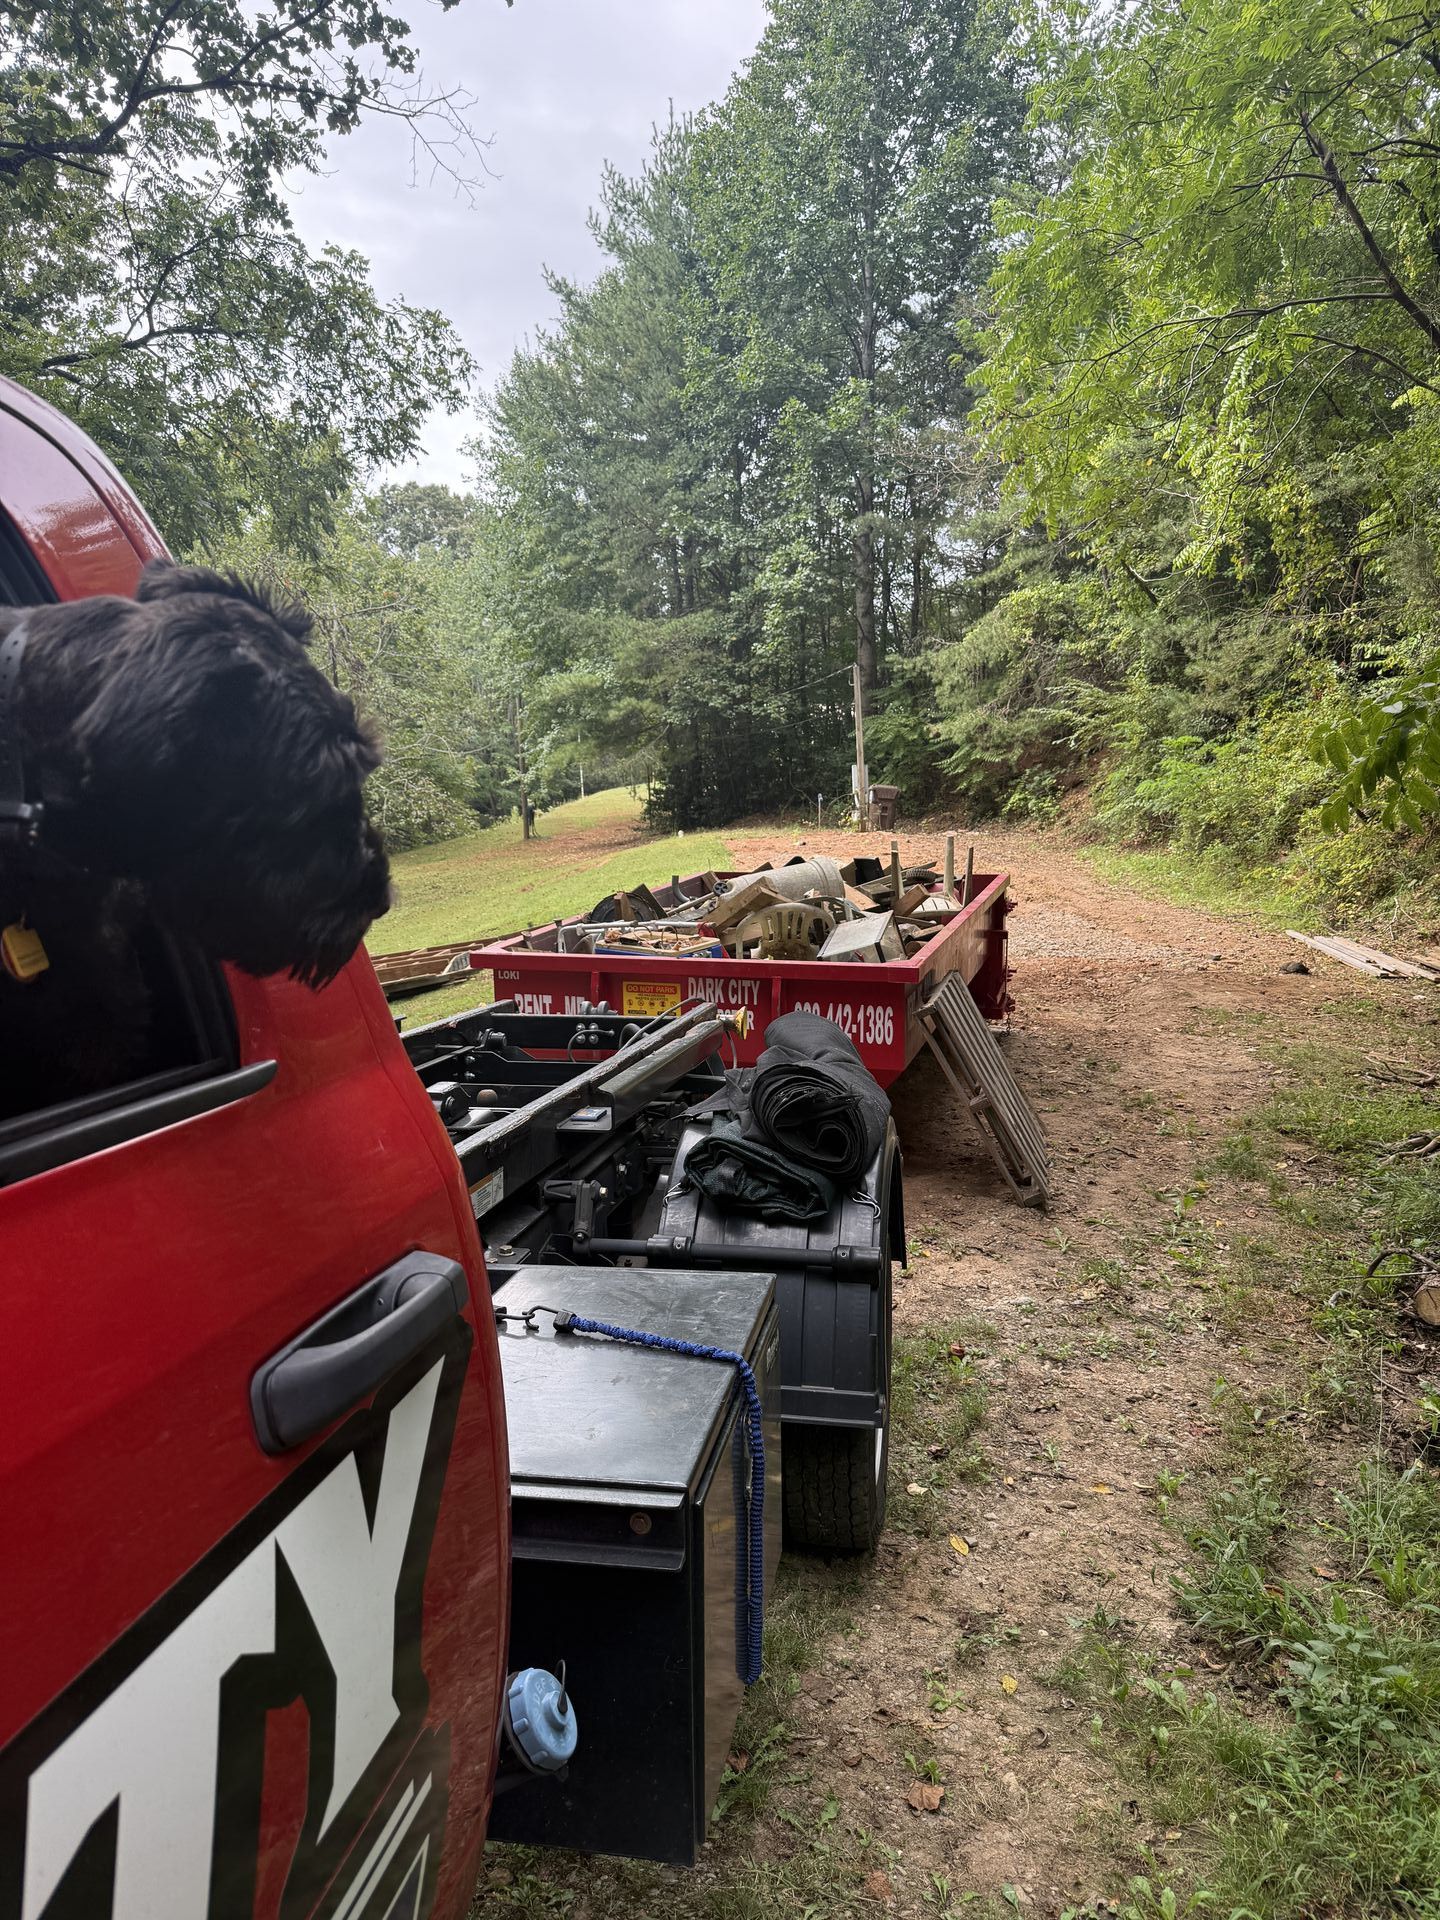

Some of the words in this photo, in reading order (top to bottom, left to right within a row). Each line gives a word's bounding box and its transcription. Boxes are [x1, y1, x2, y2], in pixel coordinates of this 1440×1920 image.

[498, 970, 520, 980] LOKI
[655, 986, 676, 994] PARK
[687, 976, 725, 1004] DARK
[728, 979, 760, 1006] CITY
